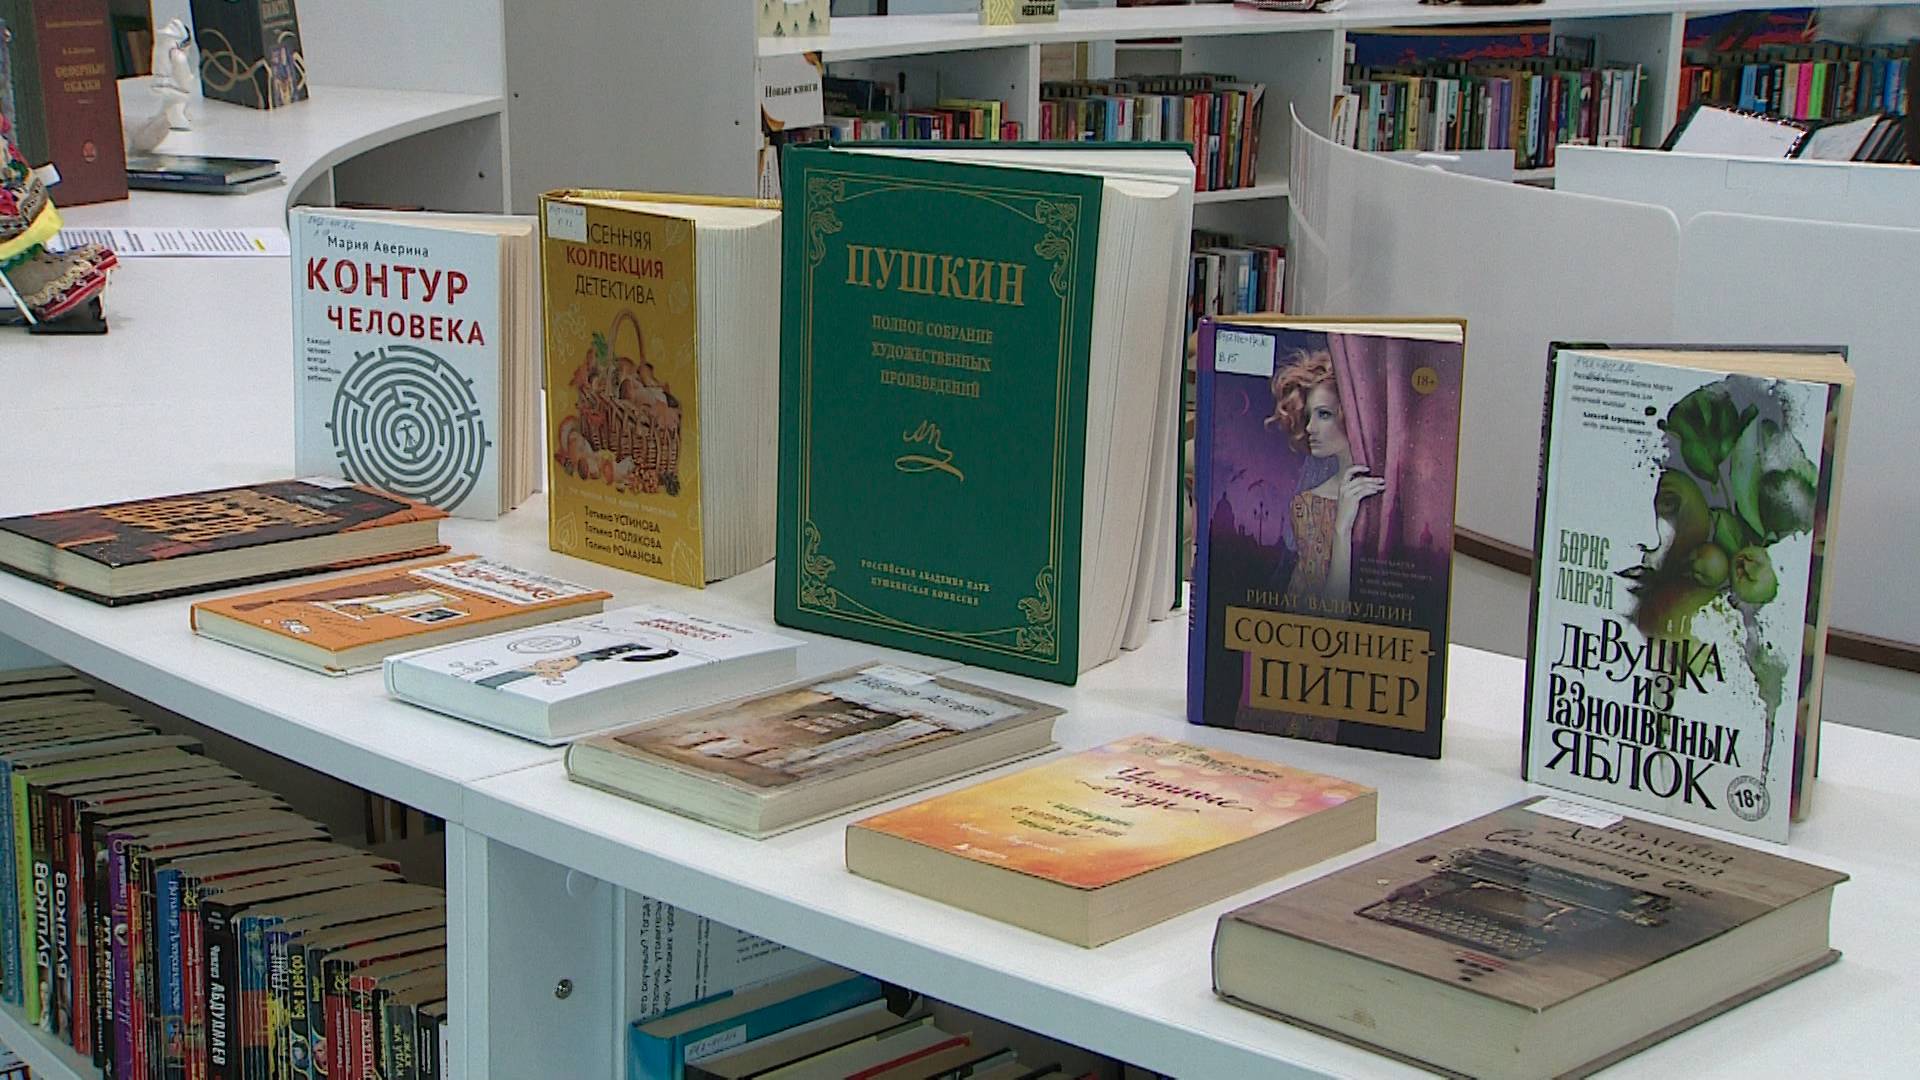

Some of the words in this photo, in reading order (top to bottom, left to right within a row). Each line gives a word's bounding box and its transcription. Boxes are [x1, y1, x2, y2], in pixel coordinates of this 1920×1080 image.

[1022, 4, 1055, 16] HERITAGE
[765, 85, 792, 98] Новые
[327, 236, 369, 251] Мария
[373, 240, 429, 257] Аверина
[587, 223, 652, 251] СЕННЯЯ
[566, 246, 664, 279] КОЛЛЕКЦИЯ
[845, 243, 1027, 306] ПУШКИН
[306, 256, 469, 304] КОНТУР
[575, 274, 657, 305] ДЕТЕКТИВА
[327, 306, 486, 346] ЧЕЛОВЕКА
[872, 314, 924, 335] ПОЛНОЕ
[926, 323, 993, 344] СОБРАНИЕ
[871, 341, 993, 372] ХУДОЖЕСТВЕННЫХ
[880, 369, 980, 398] ПРОИЗВЕДЕНИЙ
[1416, 375, 1435, 386] 18+
[614, 512, 661, 533] УСТИНОВА
[614, 529, 662, 550] ПОЛЯКОВА
[613, 545, 663, 565] РОМАНОВА
[861, 559, 916, 578] РОССИЙСКАЯ
[919, 571, 964, 587] АКАДЕМИЯ
[871, 577, 929, 596] ПУШКИНСКАЯ
[931, 589, 979, 606] КОМИССИЯ
[1246, 589, 1298, 607] РИНАТ
[1308, 596, 1413, 622] ВАЛИУЛЛИН
[1260, 657, 1420, 717] ПИТЕР
[1545, 729, 1717, 810] ЯБЛОК
[1734, 789, 1762, 809] 18+
[34, 861, 49, 968] БУШКОВ
[55, 871, 68, 978] БУШКОВ
[209, 982, 226, 1066] АБДУЛЛАЕВ
